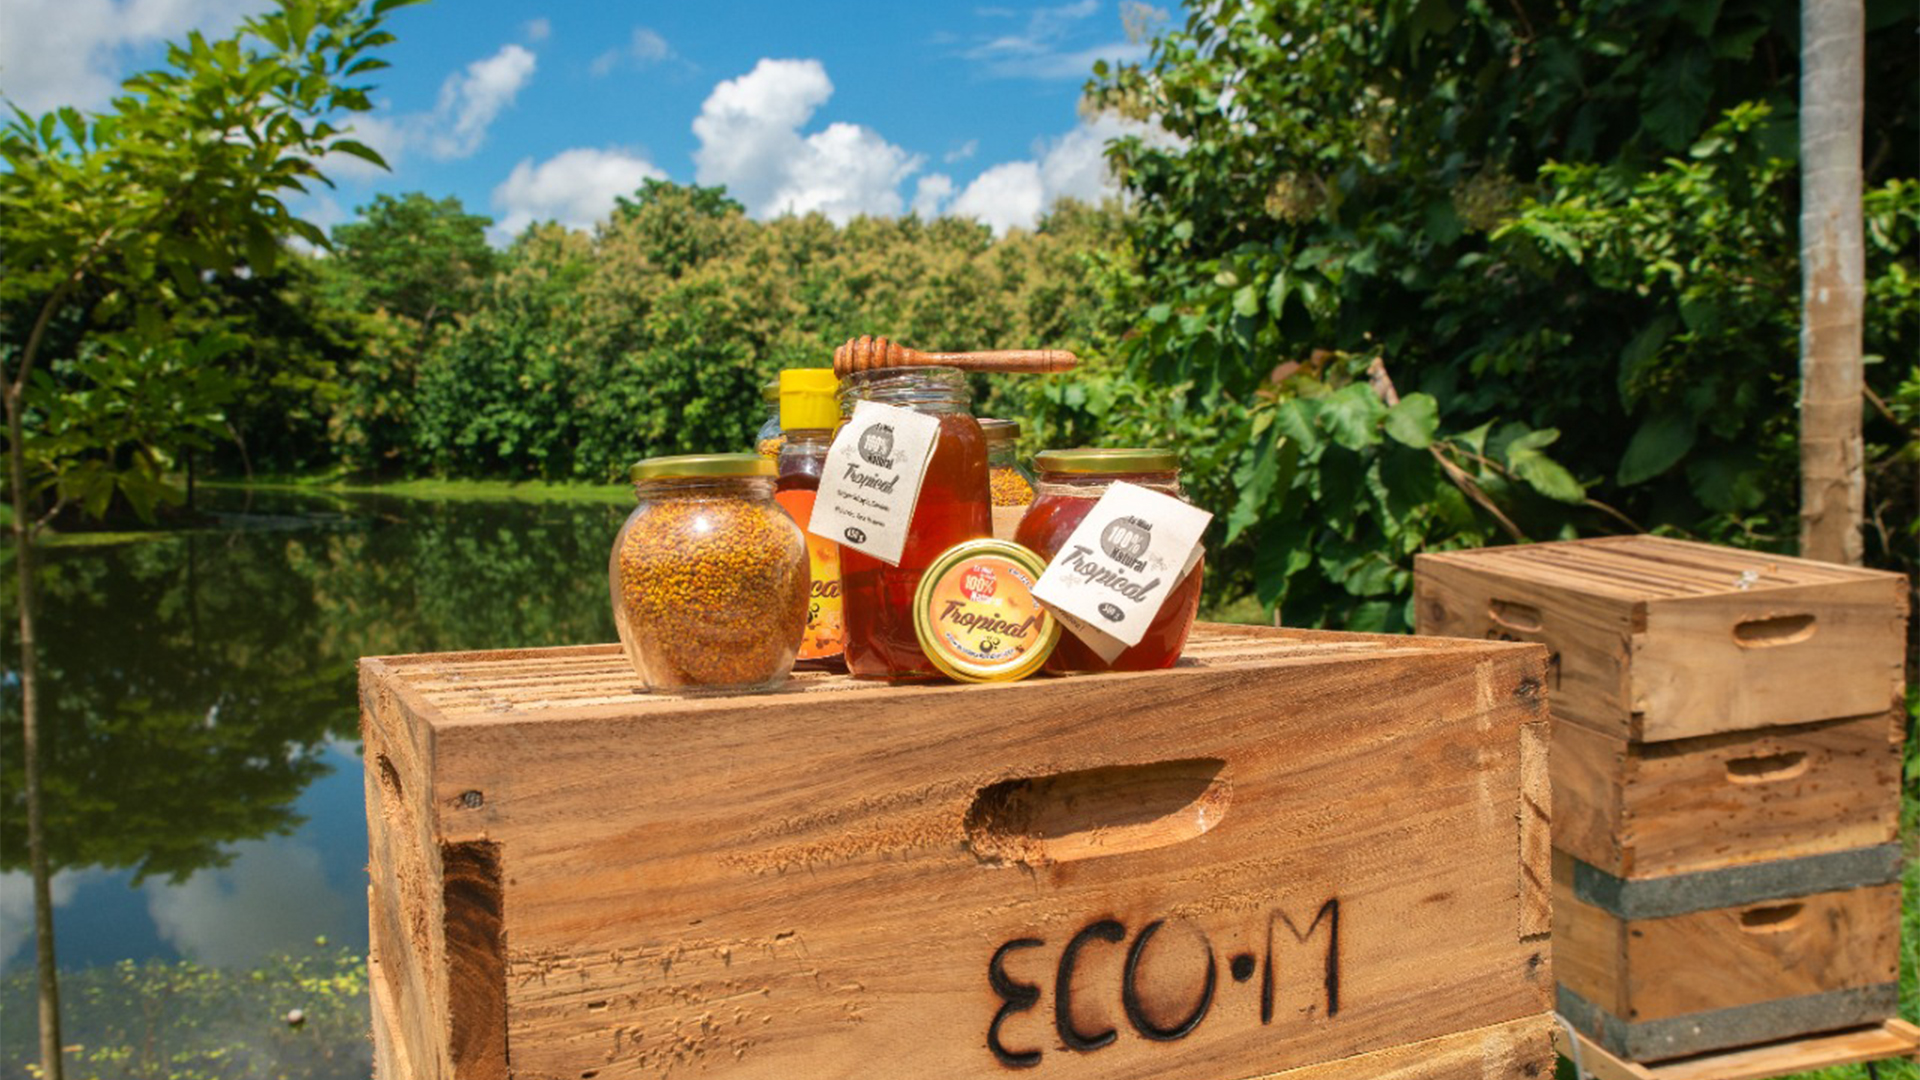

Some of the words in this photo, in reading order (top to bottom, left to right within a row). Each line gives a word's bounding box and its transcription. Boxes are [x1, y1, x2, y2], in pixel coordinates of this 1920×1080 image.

[842, 463, 900, 495] Tropical
[1107, 526, 1144, 554] 100%
[1061, 545, 1161, 603] Tropical
[1110, 547, 1148, 574] Natural
[965, 575, 994, 593] 100%
[940, 600, 1035, 639] Tropical
